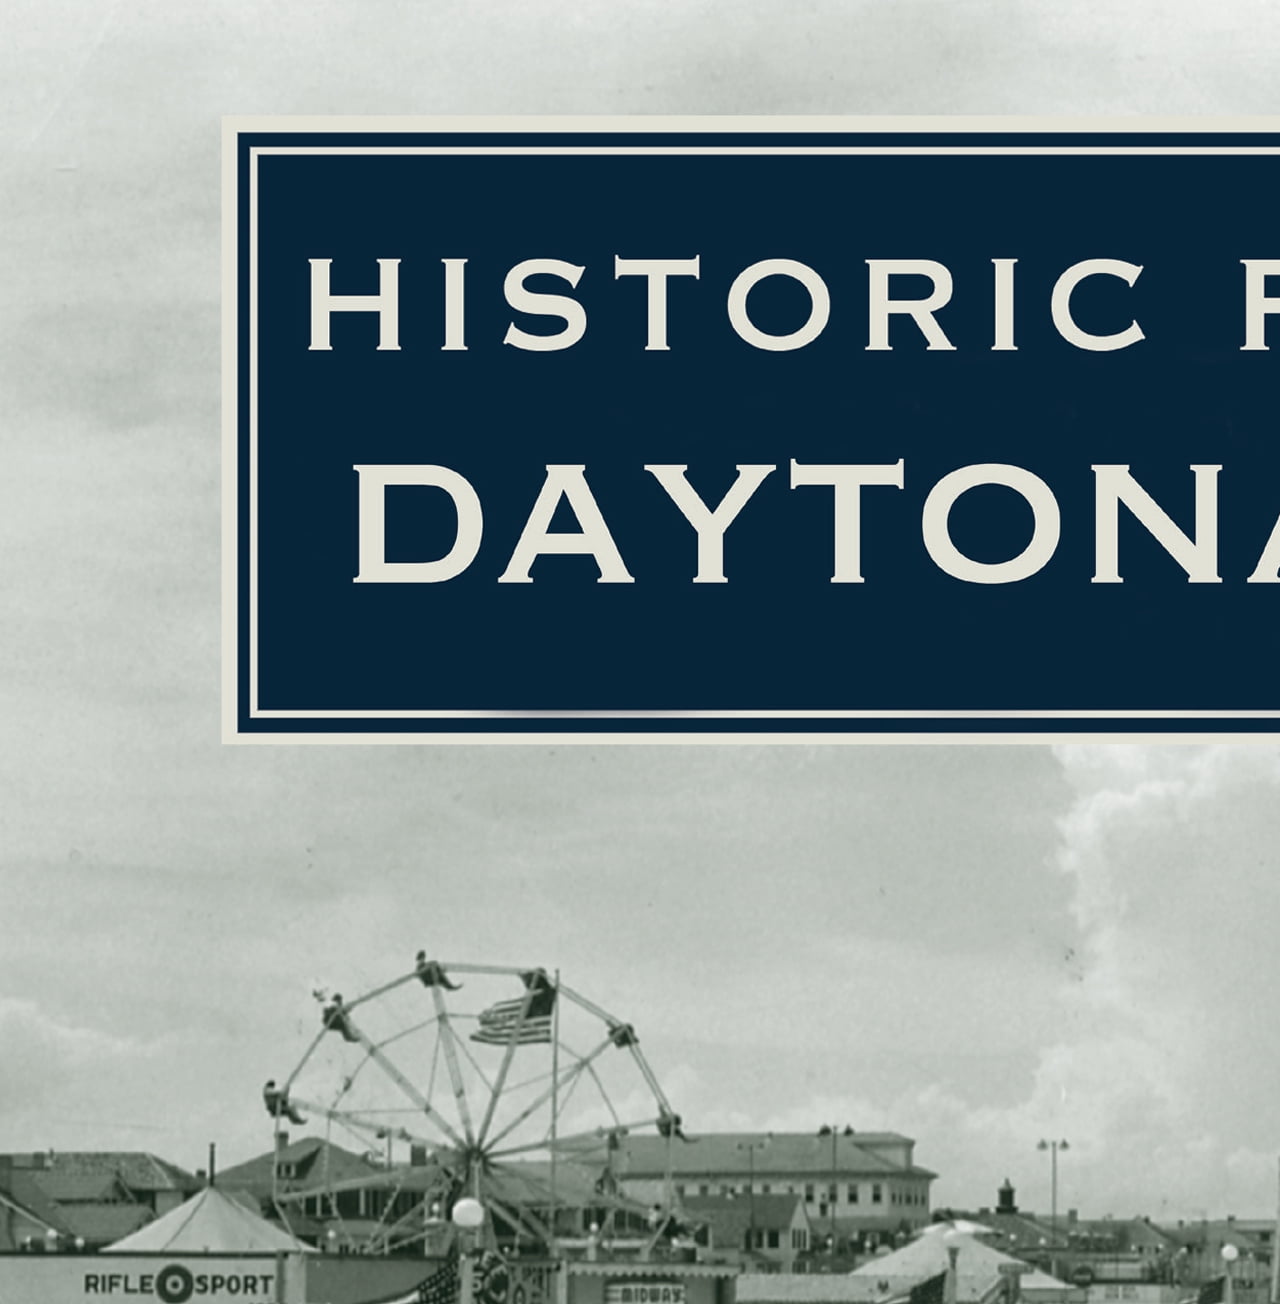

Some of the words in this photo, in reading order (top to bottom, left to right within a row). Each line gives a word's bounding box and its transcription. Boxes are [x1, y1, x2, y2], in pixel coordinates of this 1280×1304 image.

[84, 1274, 154, 1294] RIFLE
[194, 1274, 274, 1295] SPORT
[621, 1286, 681, 1304] MIDWAY
